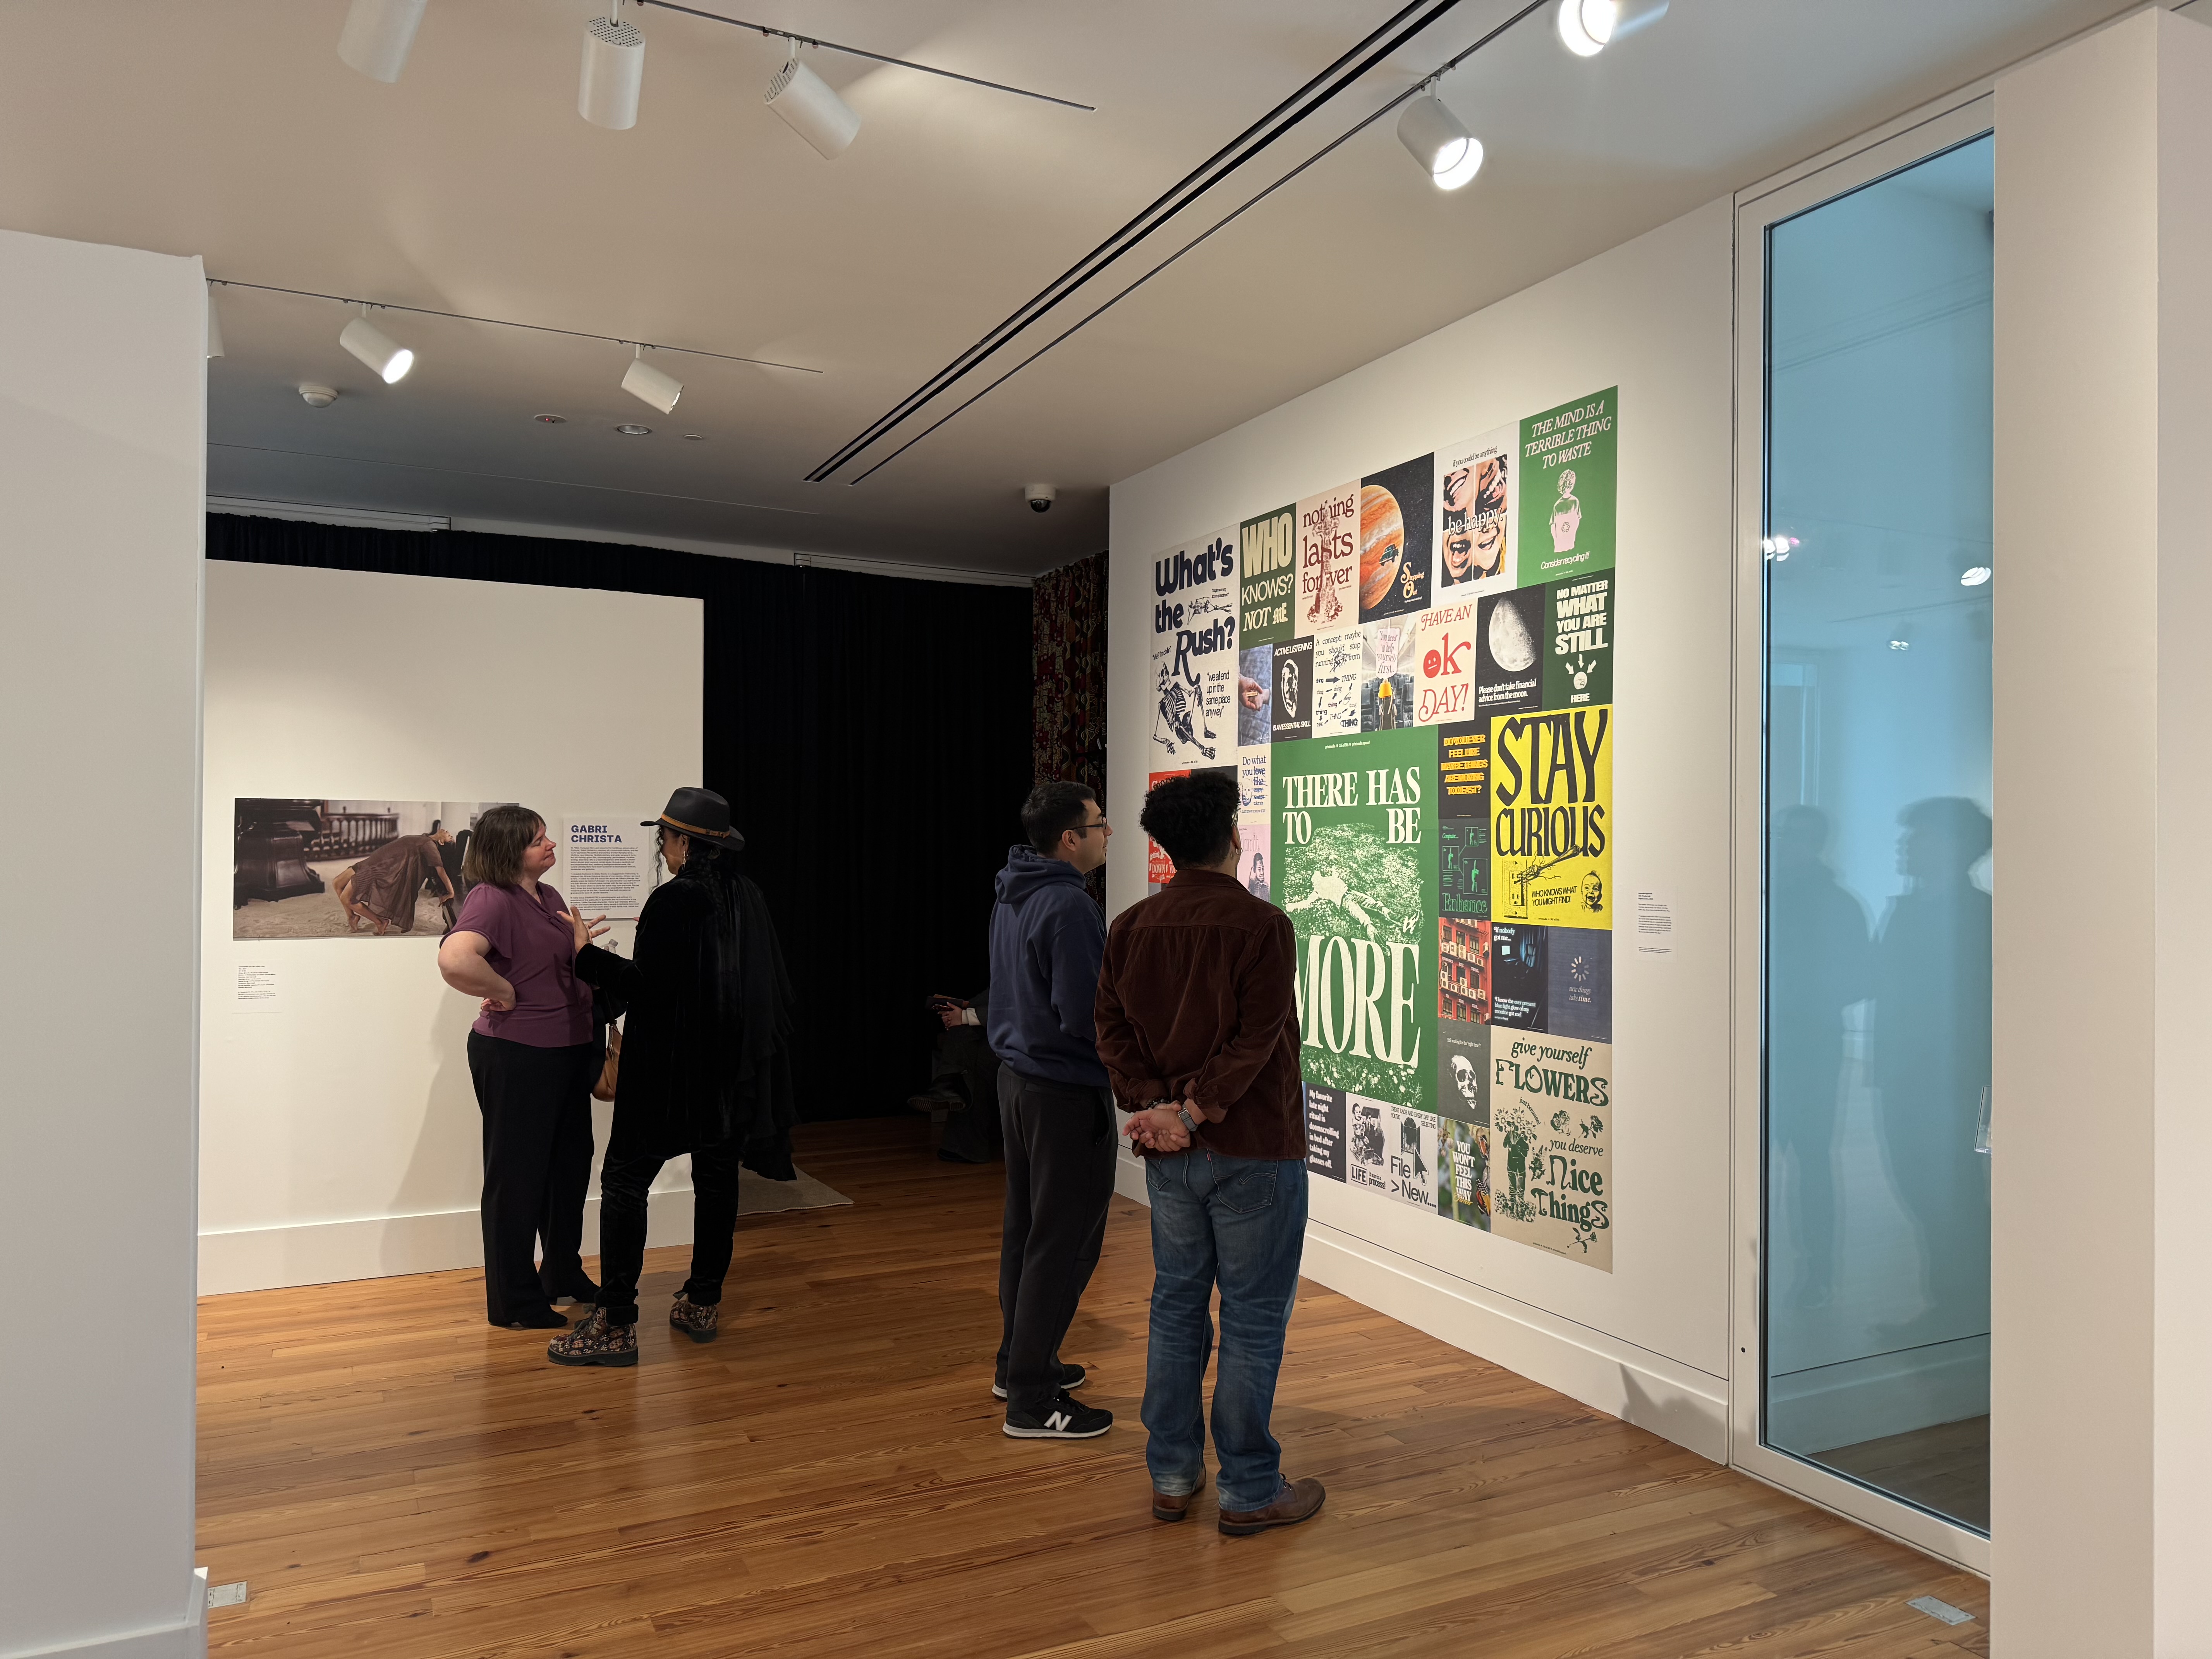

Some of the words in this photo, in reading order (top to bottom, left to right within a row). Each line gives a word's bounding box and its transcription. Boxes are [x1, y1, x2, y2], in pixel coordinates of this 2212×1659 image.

[1532, 418, 1553, 437] THE
[1554, 408, 1584, 429] MIND
[1585, 403, 1595, 419] IS
[1595, 400, 1604, 415] A
[1525, 429, 1575, 457] TERRIBLE
[1576, 416, 1612, 440] THING
[1463, 453, 1474, 463] could
[1480, 446, 1497, 457] anything
[1543, 453, 1557, 469] TO
[1558, 441, 1592, 464] WASTE
[1448, 516, 1462, 535] be
[1464, 508, 1503, 532] happy.
[1242, 512, 1293, 579] WHO
[1156, 537, 1233, 597] What's
[1541, 558, 1563, 569] Consider
[1563, 553, 1585, 565] recycling
[1302, 566, 1352, 594] forver
[1242, 573, 1294, 606] KNOWS?
[1557, 588, 1570, 599] NO
[1571, 580, 1608, 597] MATTER
[1556, 592, 1607, 618] WHAT
[1155, 599, 1184, 634] the
[1243, 606, 1272, 632] NOT
[1421, 608, 1454, 631] HAVE
[1454, 604, 1472, 621] AN
[1556, 617, 1580, 633] YOU
[1582, 612, 1607, 629] ARE
[1345, 630, 1361, 640] maybe
[1555, 627, 1608, 655] STILL
[1171, 616, 1235, 687] Rush?
[1274, 646, 1290, 656] ACTIVE
[1290, 642, 1312, 653] LISTENING
[1316, 649, 1324, 658] you
[1329, 644, 1345, 654] should
[1350, 642, 1361, 651] stop
[1315, 658, 1333, 667] running
[1221, 669, 1230, 680] end
[1341, 673, 1357, 682] THING
[1479, 685, 1494, 694] Please
[1493, 683, 1505, 692] don't
[1505, 682, 1515, 690] take
[1516, 678, 1537, 689] financial
[1206, 697, 1218, 705] same
[1218, 694, 1231, 706] place
[1418, 683, 1468, 722] DAY!
[1478, 694, 1494, 702] advice
[1493, 692, 1505, 701] from
[1505, 690, 1513, 699] the
[1570, 693, 1590, 703] HERE
[1242, 756, 1250, 766] Do
[1251, 755, 1266, 764] what
[1496, 708, 1608, 807] STAY
[1242, 768, 1253, 778] you
[1283, 772, 1358, 809] THERE
[1366, 766, 1420, 805] HAS
[1282, 811, 1312, 845] TO
[1386, 807, 1422, 844] BE
[1496, 804, 1605, 857] CURIOUS
[1532, 890, 1544, 898] WHO
[1544, 887, 1562, 896] KNOWS
[1563, 886, 1577, 894] WHAT
[1442, 893, 1487, 914] Enhance
[1543, 897, 1558, 905] MIGHT
[1499, 927, 1515, 935] nobody
[1293, 935, 1420, 1068] MORE
[1511, 1037, 1537, 1058] give
[1537, 1046, 1592, 1070] yourself
[1496, 1058, 1609, 1106] FLOWERS
[1309, 1089, 1315, 1099] My
[1316, 1091, 1333, 1103] favorite
[1318, 1103, 1329, 1113] night
[1309, 1111, 1321, 1121] ritual
[1321, 1114, 1326, 1123] is
[1421, 1120, 1436, 1129] SELECTING
[1309, 1121, 1339, 1139] doomscrolling
[1309, 1132, 1314, 1141] in
[1314, 1133, 1322, 1143] bed
[1322, 1136, 1333, 1146] after
[1456, 1140, 1470, 1154] YOU
[1549, 1139, 1566, 1151] you
[1568, 1138, 1604, 1157] deserve
[1309, 1144, 1323, 1156] taking
[1323, 1149, 1330, 1158] my
[1452, 1151, 1475, 1167] WON'T
[1309, 1154, 1325, 1166] glasses
[1391, 1155, 1411, 1179] File
[1352, 1166, 1366, 1183] LIFE
[1455, 1164, 1472, 1178] FEEL
[1369, 1178, 1386, 1190] process!
[1455, 1175, 1472, 1190] THIS
[1456, 1187, 1472, 1201] WAY
[1044, 1411, 1072, 1431] N
